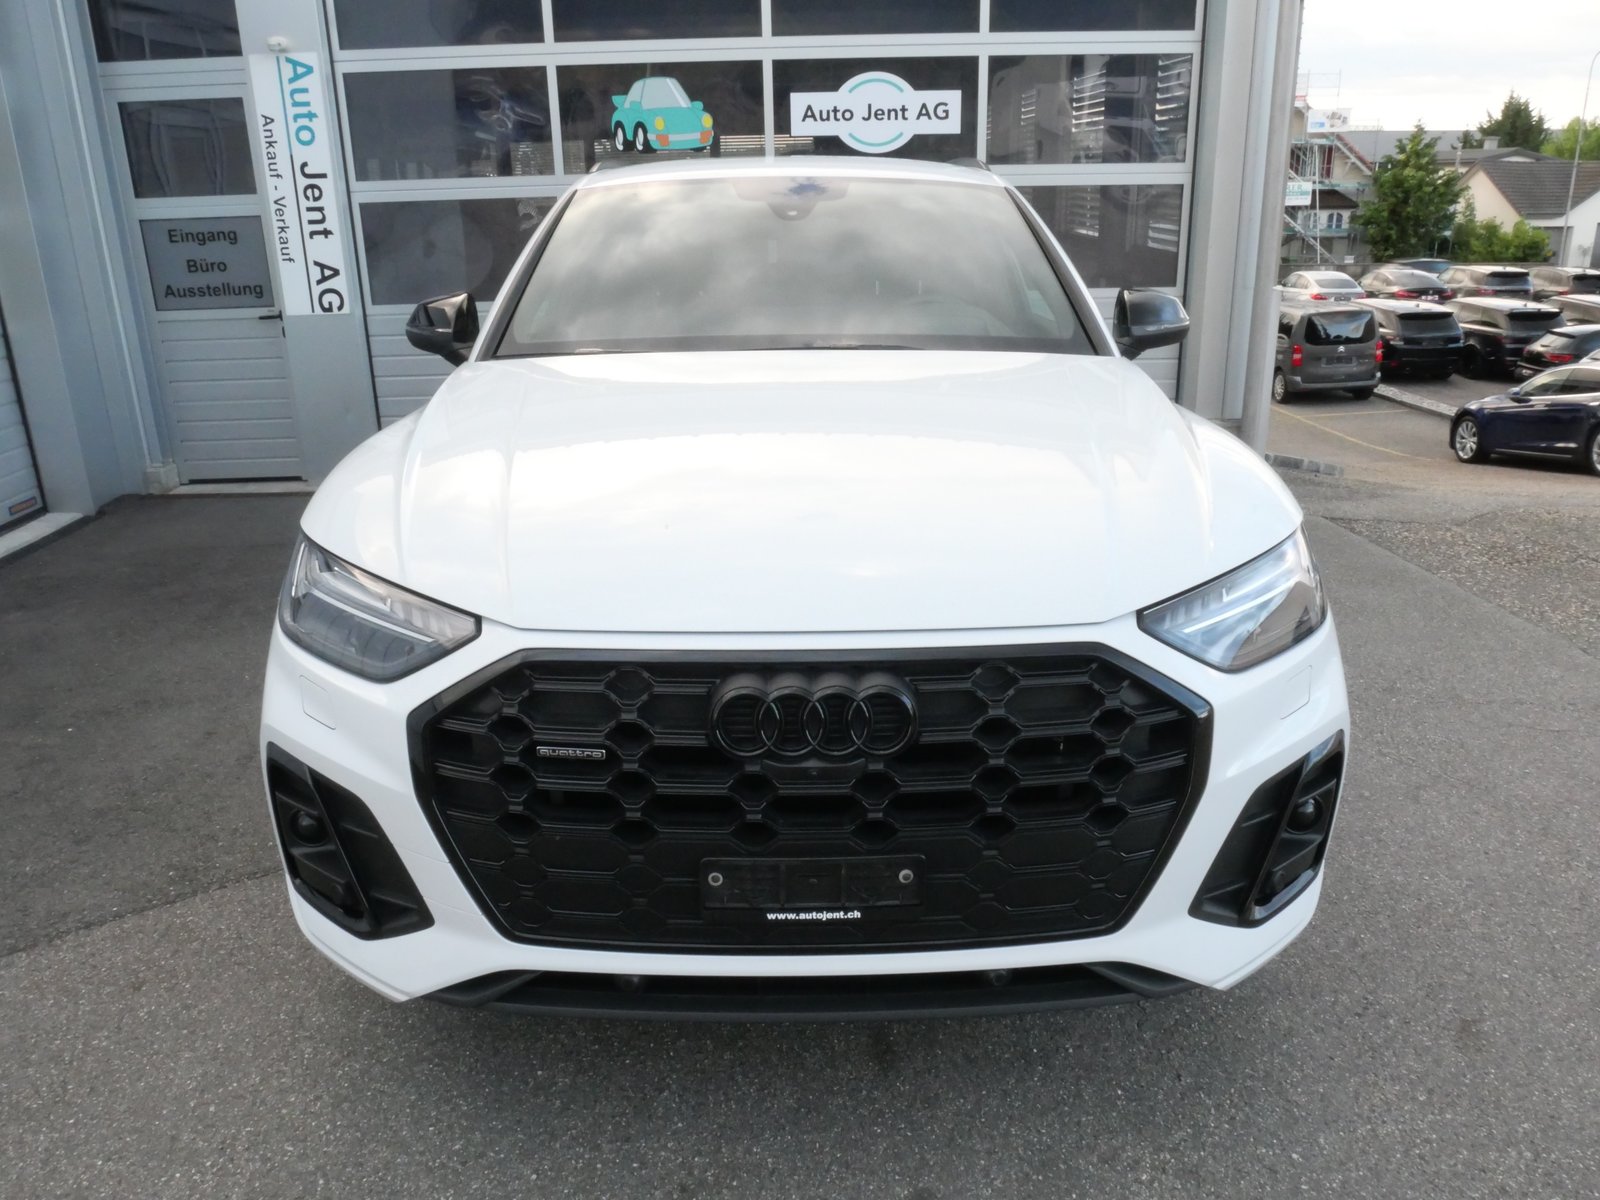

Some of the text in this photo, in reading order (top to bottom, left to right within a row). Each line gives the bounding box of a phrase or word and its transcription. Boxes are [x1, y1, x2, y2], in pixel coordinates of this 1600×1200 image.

[801, 102, 950, 122] Auto Jent AG
[261, 114, 284, 179] Ankauf
[273, 196, 295, 263] Verkauf
[285, 57, 345, 313] Auto Jent AG
[167, 228, 238, 245] Eingang
[186, 259, 227, 273] Büro
[164, 283, 264, 299] Ausstellung
[540, 749, 602, 758] quattro
[766, 910, 861, 920] www.autojent.ch
